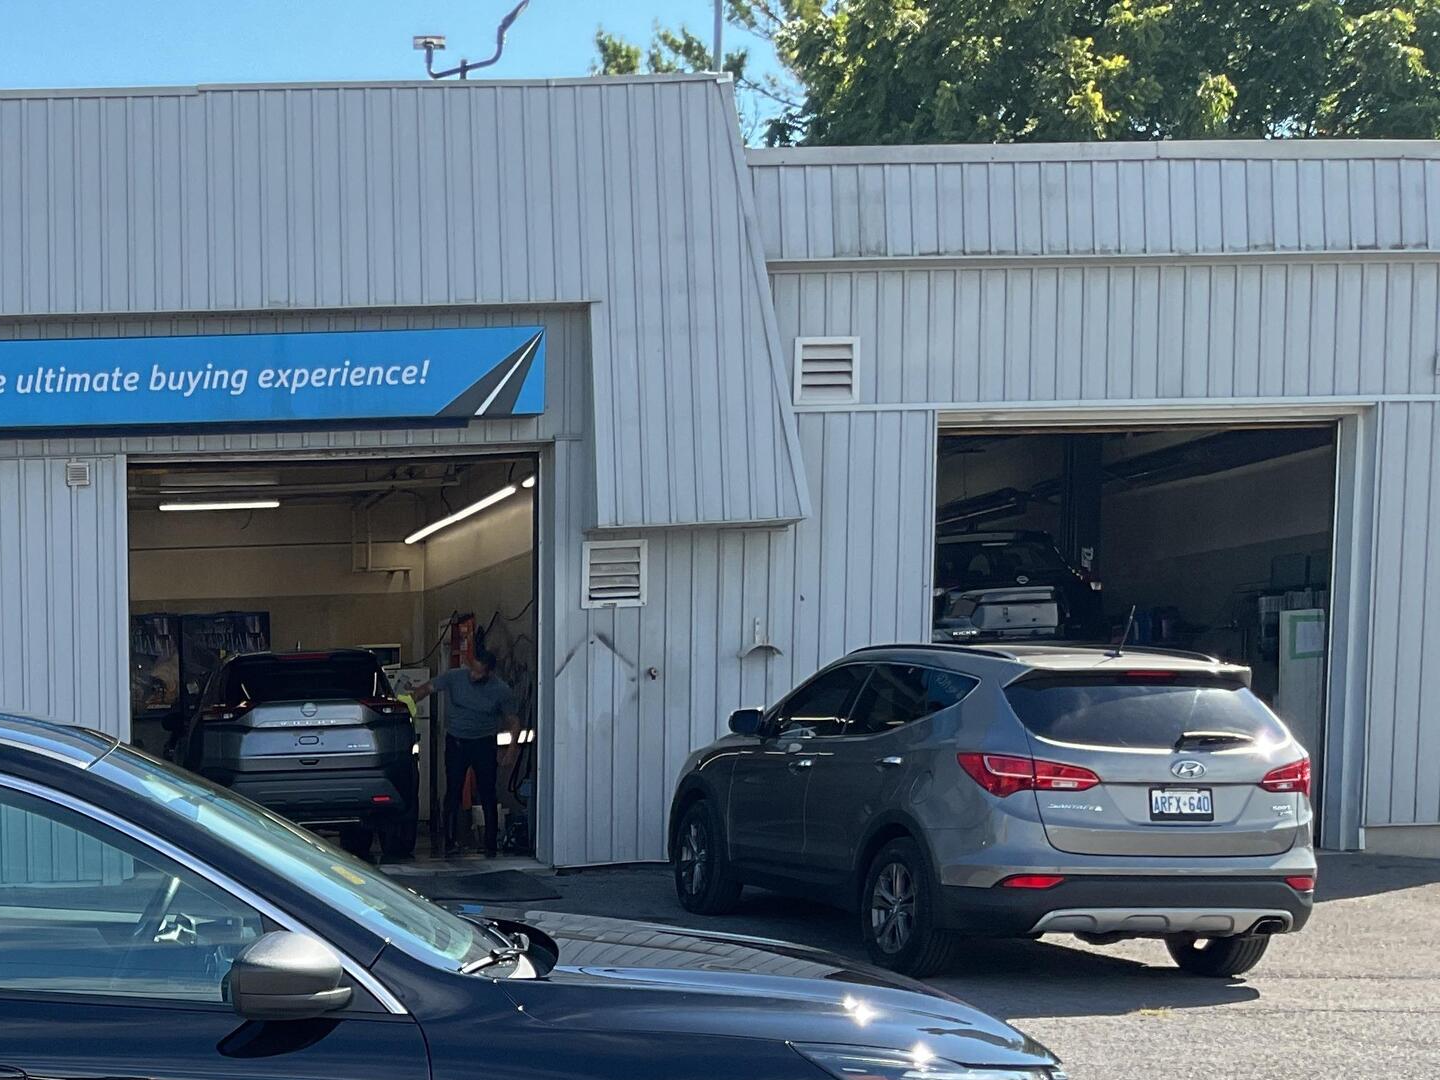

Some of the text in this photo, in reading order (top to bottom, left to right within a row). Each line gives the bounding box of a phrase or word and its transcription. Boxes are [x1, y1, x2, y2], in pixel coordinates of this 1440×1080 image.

[15, 365, 140, 395] ultimate
[148, 363, 249, 398] buying
[257, 359, 431, 395] experience!
